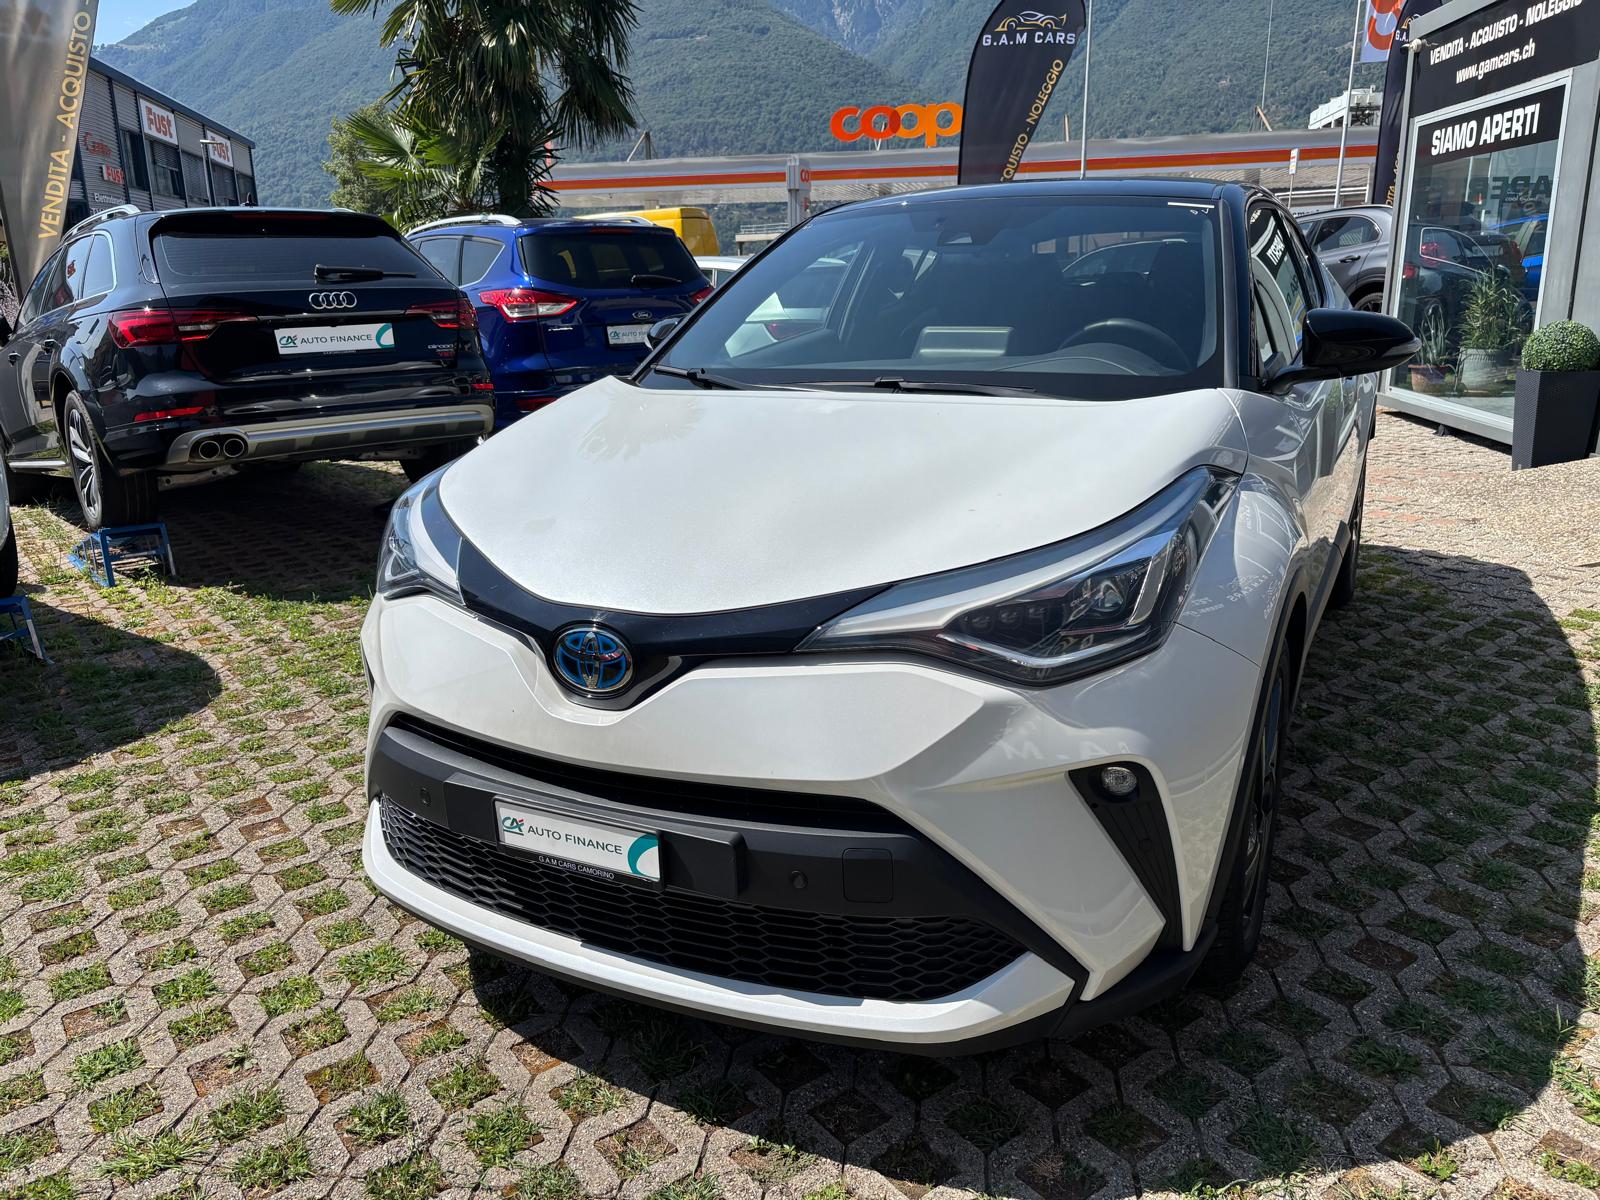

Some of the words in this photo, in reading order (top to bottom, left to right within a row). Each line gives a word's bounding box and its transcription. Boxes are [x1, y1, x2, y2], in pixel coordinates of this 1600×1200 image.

[982, 33, 1027, 47] G.A.M
[1034, 31, 1076, 45] CARS
[1395, 31, 1409, 42] G.A.
[1430, 37, 1463, 65] VENDITA
[1469, 13, 1518, 50] ACQUISTO
[1456, 38, 1536, 84] www.gamcars.ch
[38, 150, 70, 238] VENDITA
[56, 12, 91, 129] ACQUISTO
[146, 105, 173, 139] Fust
[830, 102, 963, 148] coop
[1003, 133, 1028, 179] QUISTO
[1026, 59, 1064, 125] NOLEGGIO
[1431, 120, 1477, 156] SIAMO
[1480, 103, 1541, 146] APERTI
[211, 135, 230, 162] Fust
[300, 336, 328, 345] AUTO
[330, 333, 373, 344] FINANCE
[527, 825, 562, 840] AUTO
[565, 833, 623, 855] FINANCE
[558, 860, 577, 871] CARS
[577, 864, 615, 880] CAMORINO
